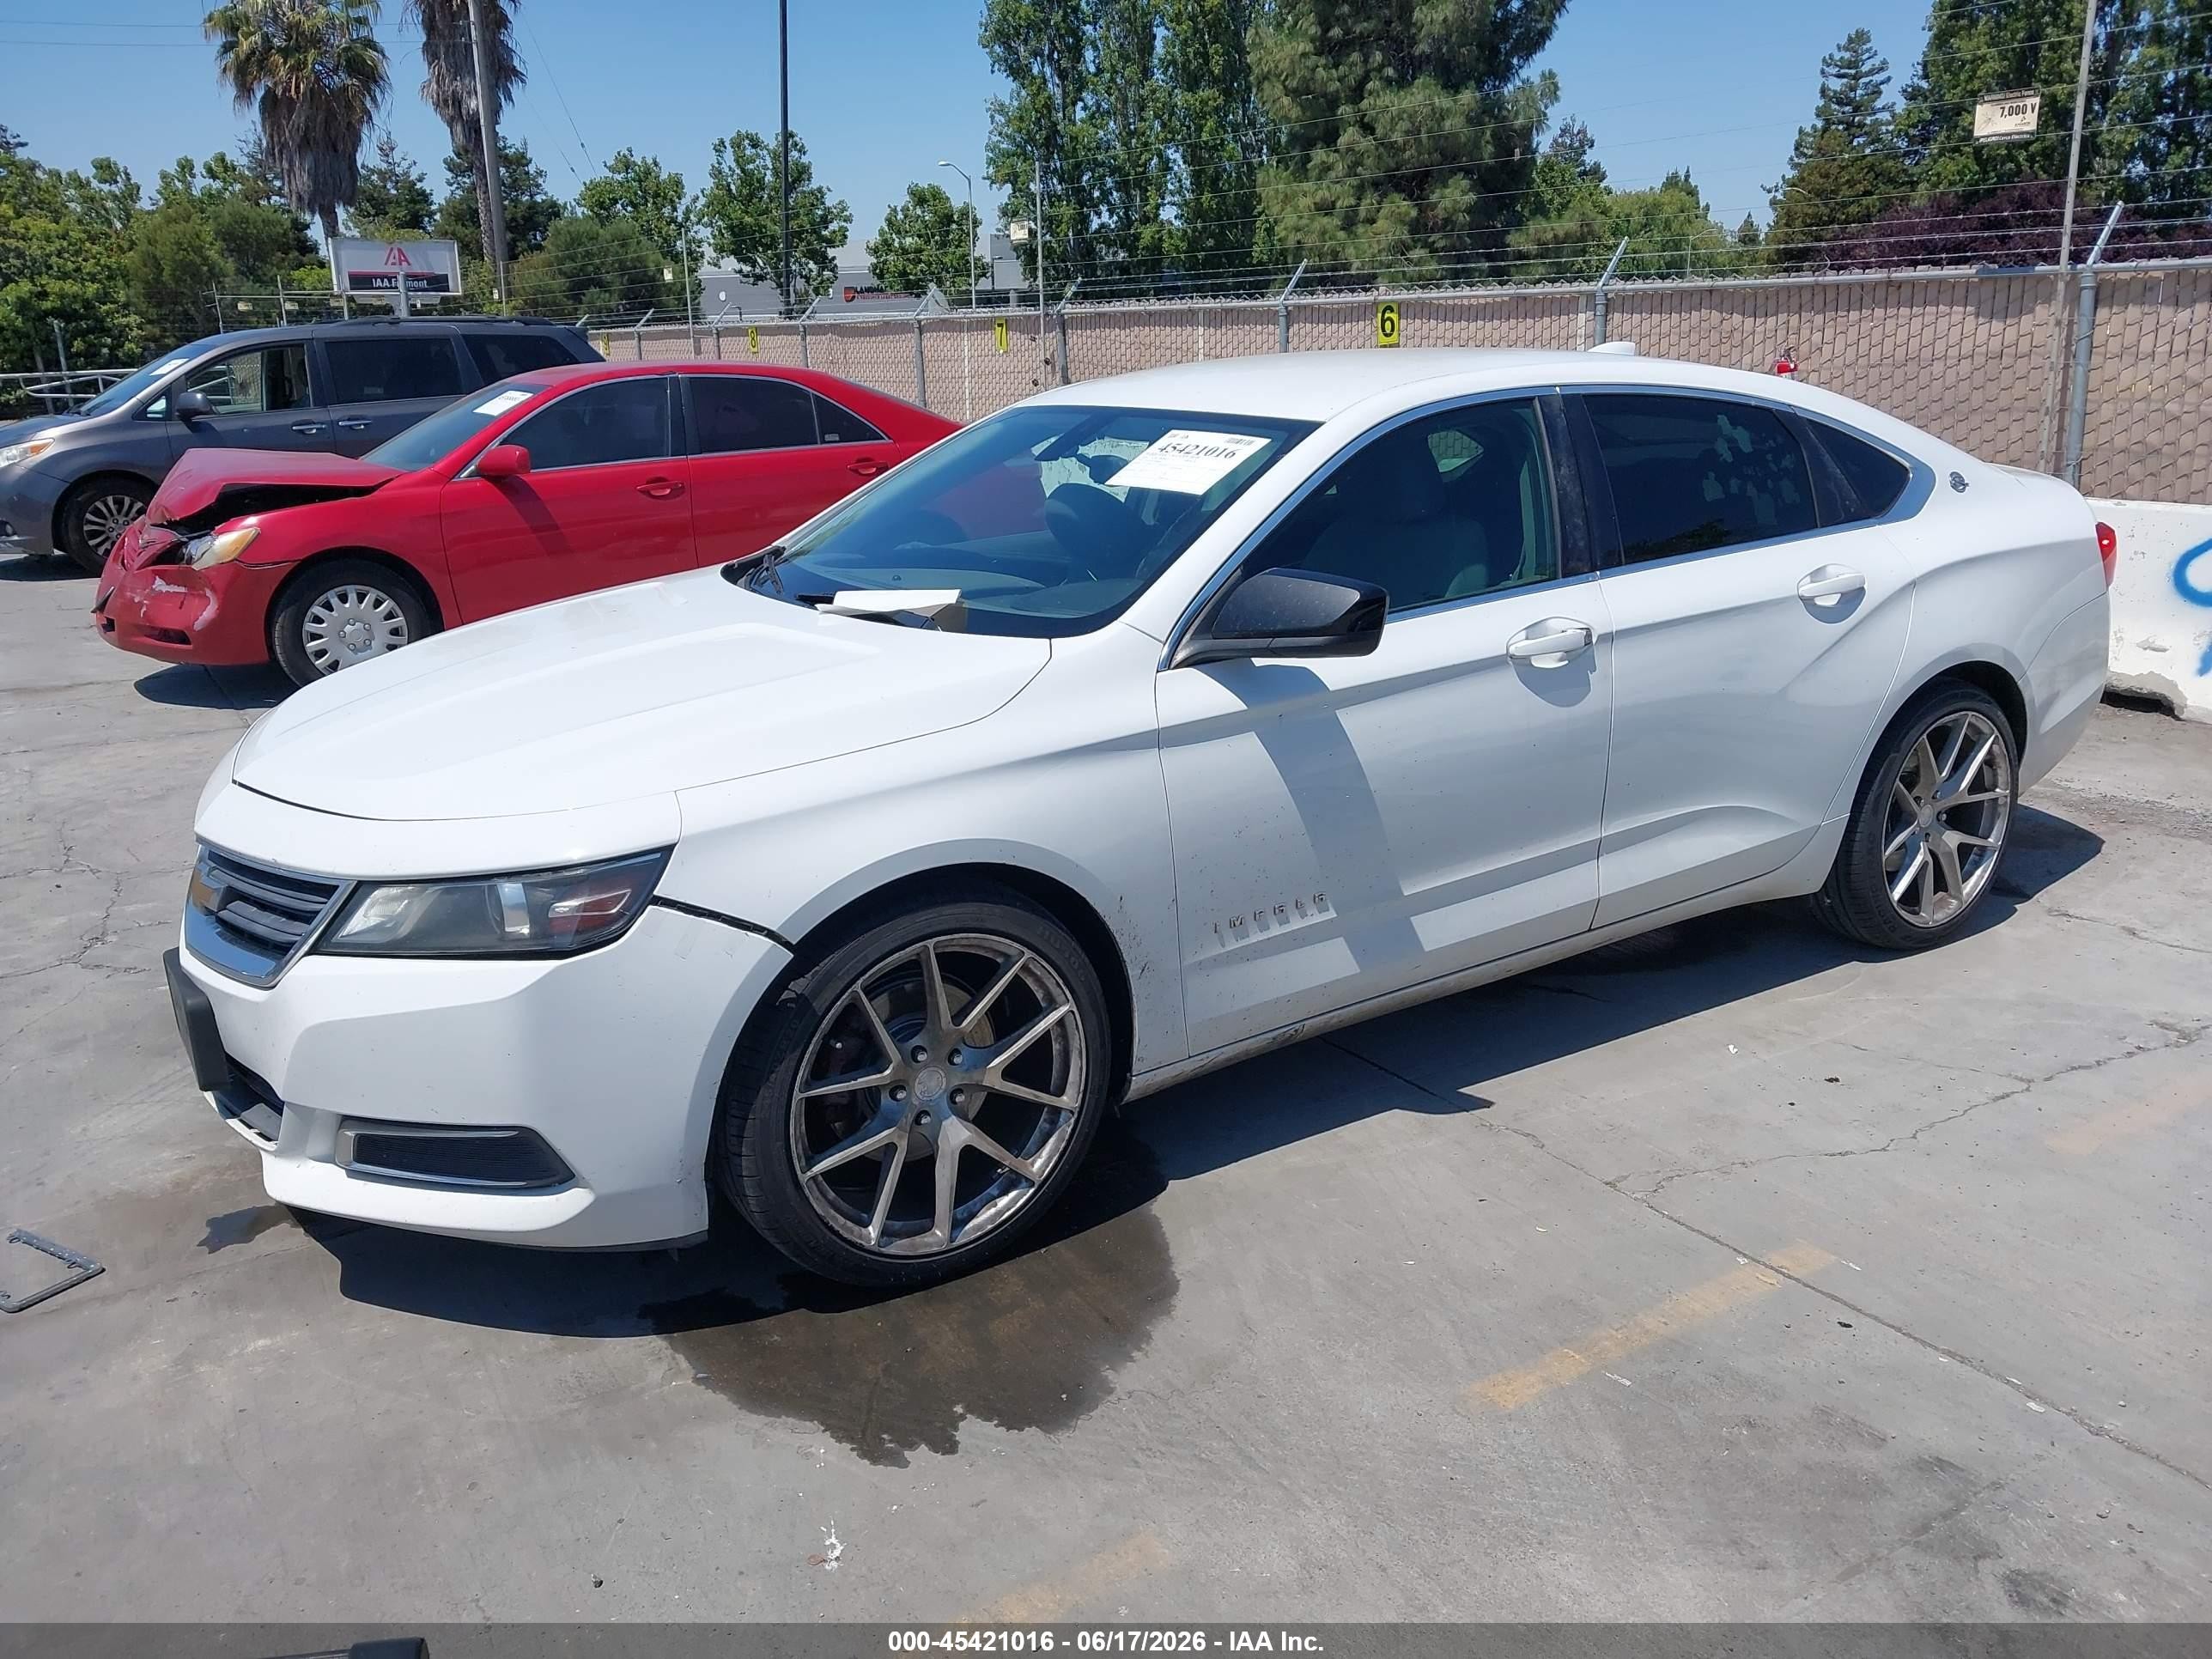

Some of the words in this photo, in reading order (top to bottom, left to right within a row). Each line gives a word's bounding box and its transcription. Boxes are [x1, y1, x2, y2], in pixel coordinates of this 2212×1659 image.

[2000, 103, 2027, 118] 7,000
[2030, 102, 2037, 113] V
[372, 278, 390, 288] IAA
[1381, 305, 1395, 337] 6
[750, 330, 757, 348] 8
[997, 323, 1004, 347] 7
[1158, 442, 1243, 459] 45421016
